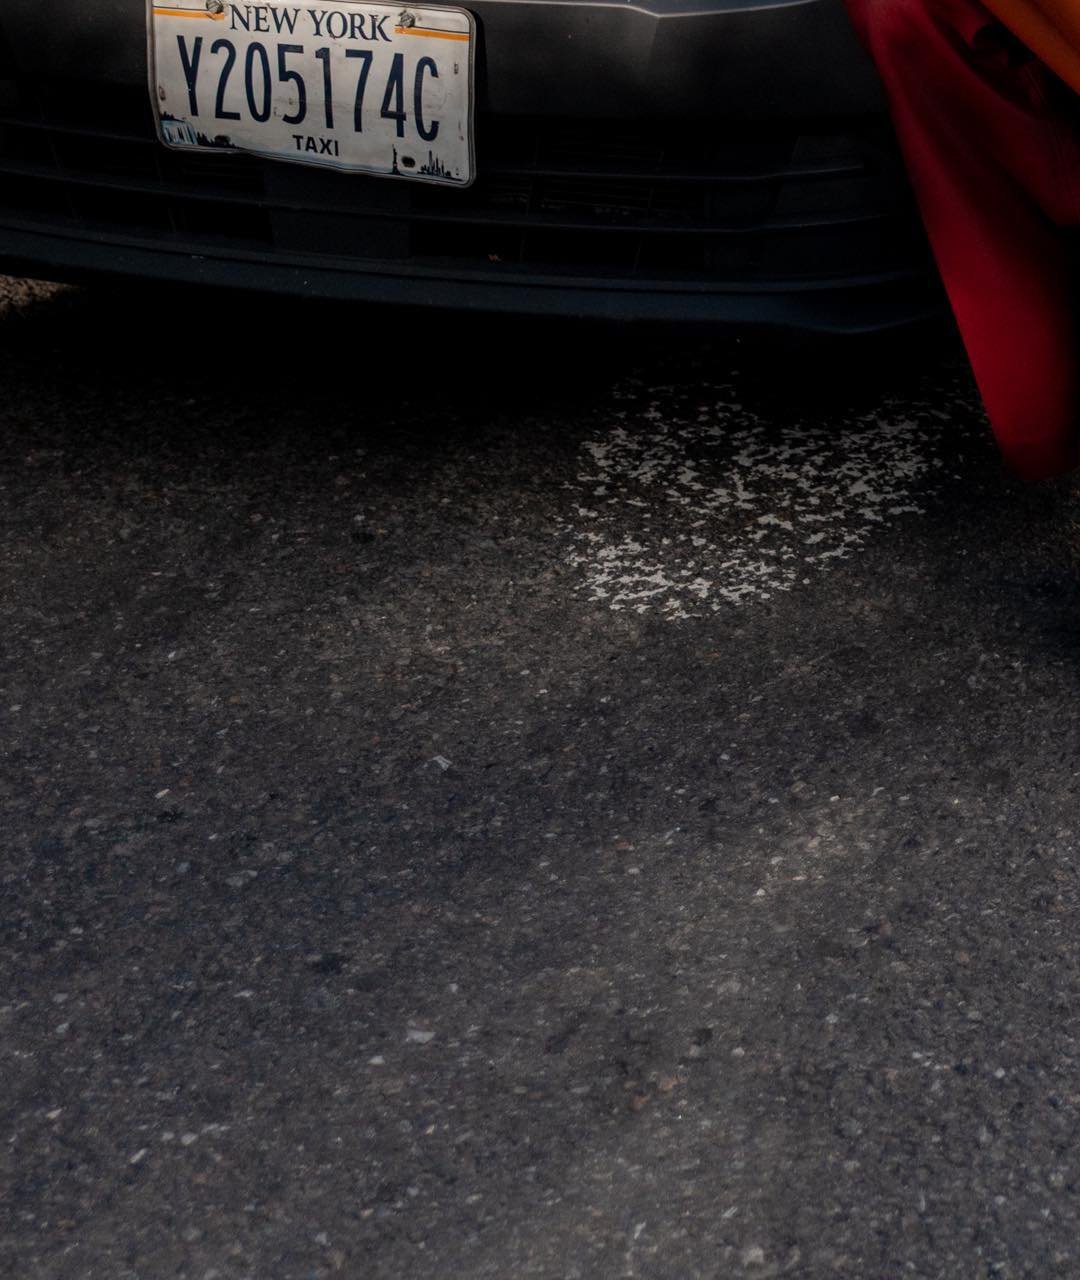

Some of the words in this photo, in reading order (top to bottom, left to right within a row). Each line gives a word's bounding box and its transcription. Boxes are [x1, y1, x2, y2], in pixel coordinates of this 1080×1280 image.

[229, 3, 300, 35] NEW
[306, 9, 393, 42] YORK
[176, 34, 440, 142] Y205174C
[292, 134, 339, 157] TAXI
